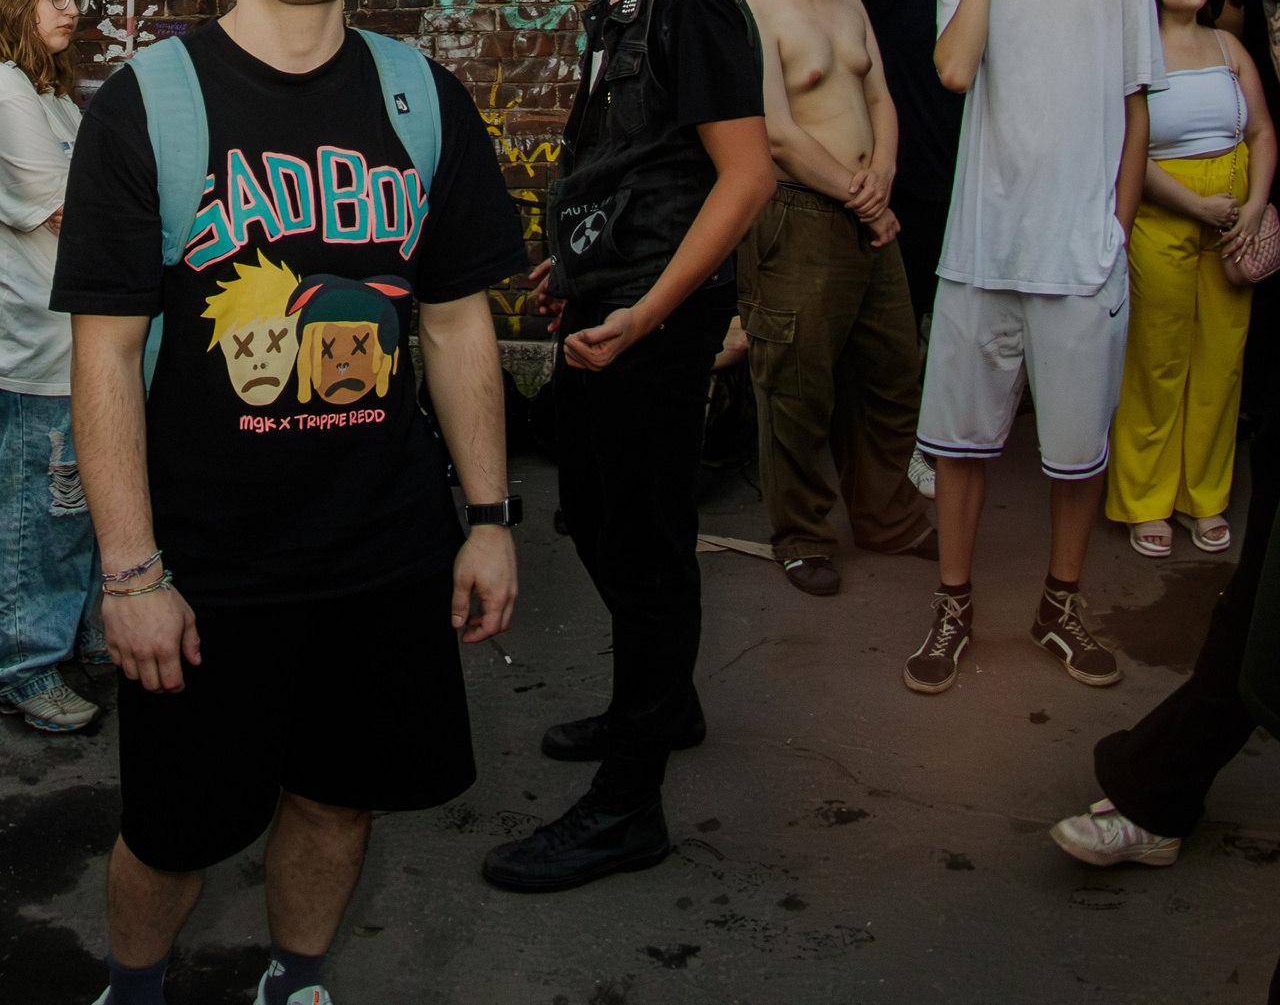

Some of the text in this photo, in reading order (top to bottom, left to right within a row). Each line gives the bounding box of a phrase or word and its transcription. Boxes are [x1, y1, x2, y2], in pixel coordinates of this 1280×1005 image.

[183, 144, 430, 272] SAD BOY
[293, 413, 347, 431] TRIPPIE
[349, 409, 386, 427] REDD
